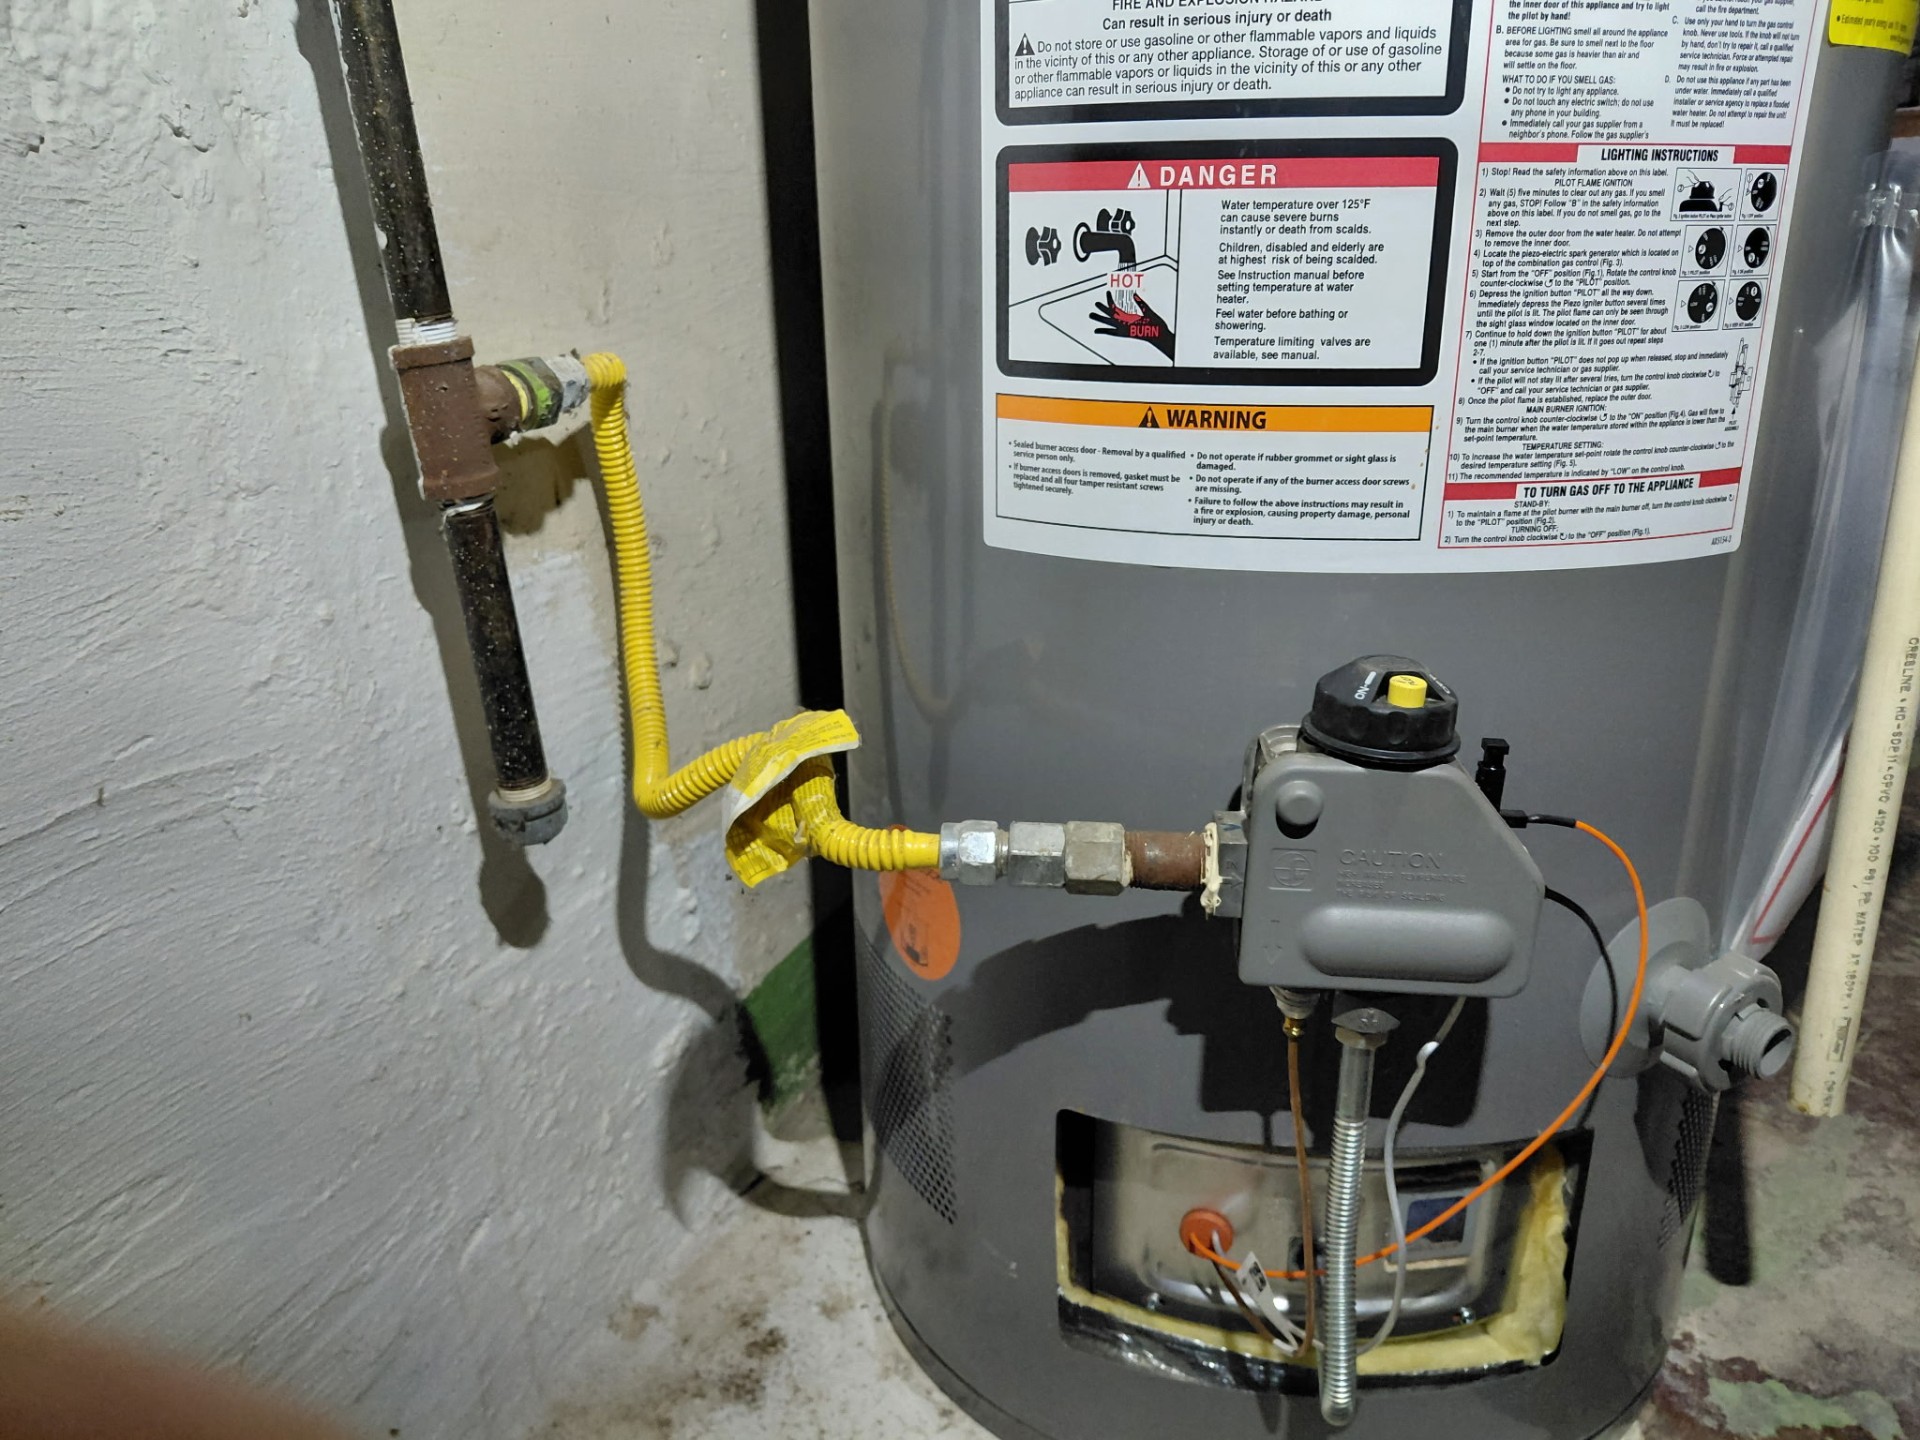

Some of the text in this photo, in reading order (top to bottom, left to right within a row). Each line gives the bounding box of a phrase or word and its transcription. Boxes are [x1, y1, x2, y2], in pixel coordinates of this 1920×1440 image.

[1112, 0, 1141, 10] FIRE
[1102, 8, 1331, 30] Can result in serious injury or death
[1037, 25, 1436, 52] Do not store or use gasoline or other flammable vapors and liquids
[1014, 42, 1442, 69] in the vicinty of this or any other appliance. Storage of or use of gasoline
[1501, 74, 1615, 84] WHAT TO DO IF YOU SMELL GAS:
[1014, 77, 1271, 101] appliance can result in serious injury or death.
[1600, 148, 1718, 161] LIGHTING INSTRUCTIONS
[1159, 164, 1276, 186] DANGER
[1554, 178, 1633, 186] PILOT FLAME IGNITION
[1221, 198, 1370, 211] Water temperature over 125°F
[1220, 211, 1339, 222] can cause severe burns
[1219, 223, 1371, 236] instantly or death from scalds.
[1218, 241, 1384, 254] Children, disabled and elderly are
[1218, 252, 1377, 266] at highest risk of being scalded.
[1110, 273, 1144, 288] HOT
[1217, 269, 1364, 279] See Instruction manual before
[1216, 282, 1354, 294] setting temperature at water
[1216, 292, 1249, 303] heater.
[1215, 308, 1348, 320] Feel water before bathing or
[1130, 325, 1159, 337] BURN
[1214, 320, 1266, 332] showering.
[1214, 335, 1370, 348] Temperature limiting valves are
[1212, 349, 1319, 360] available, see manual.
[1525, 403, 1607, 413] MAIN BURNER IGNITION:
[1166, 408, 1266, 428] WARNING
[1521, 440, 1604, 450] TEMPERATURE SETTING:
[1196, 451, 1207, 459] Do
[1224, 453, 1255, 462] operate
[1257, 452, 1264, 461] if
[1264, 453, 1293, 461] rubber
[1294, 454, 1332, 463] grommet
[1344, 454, 1365, 464] sight
[1367, 454, 1388, 464] glass
[1389, 454, 1396, 462] is
[1196, 462, 1236, 472] damaged.
[1522, 477, 1693, 498] TO TURN GAS OFF TO THE APPLIANCE
[1194, 496, 1221, 505] Failure
[1232, 497, 1258, 506] follow
[1259, 498, 1273, 506] the
[1274, 499, 1299, 507] above
[1300, 499, 1349, 508] instructions
[1350, 501, 1368, 510] may
[1369, 499, 1393, 508] result
[1395, 500, 1403, 508] in
[1510, 523, 1558, 533] TURNING OFF:
[1872, 809, 1887, 834] 4120
[1340, 849, 1442, 869] CAUTION
